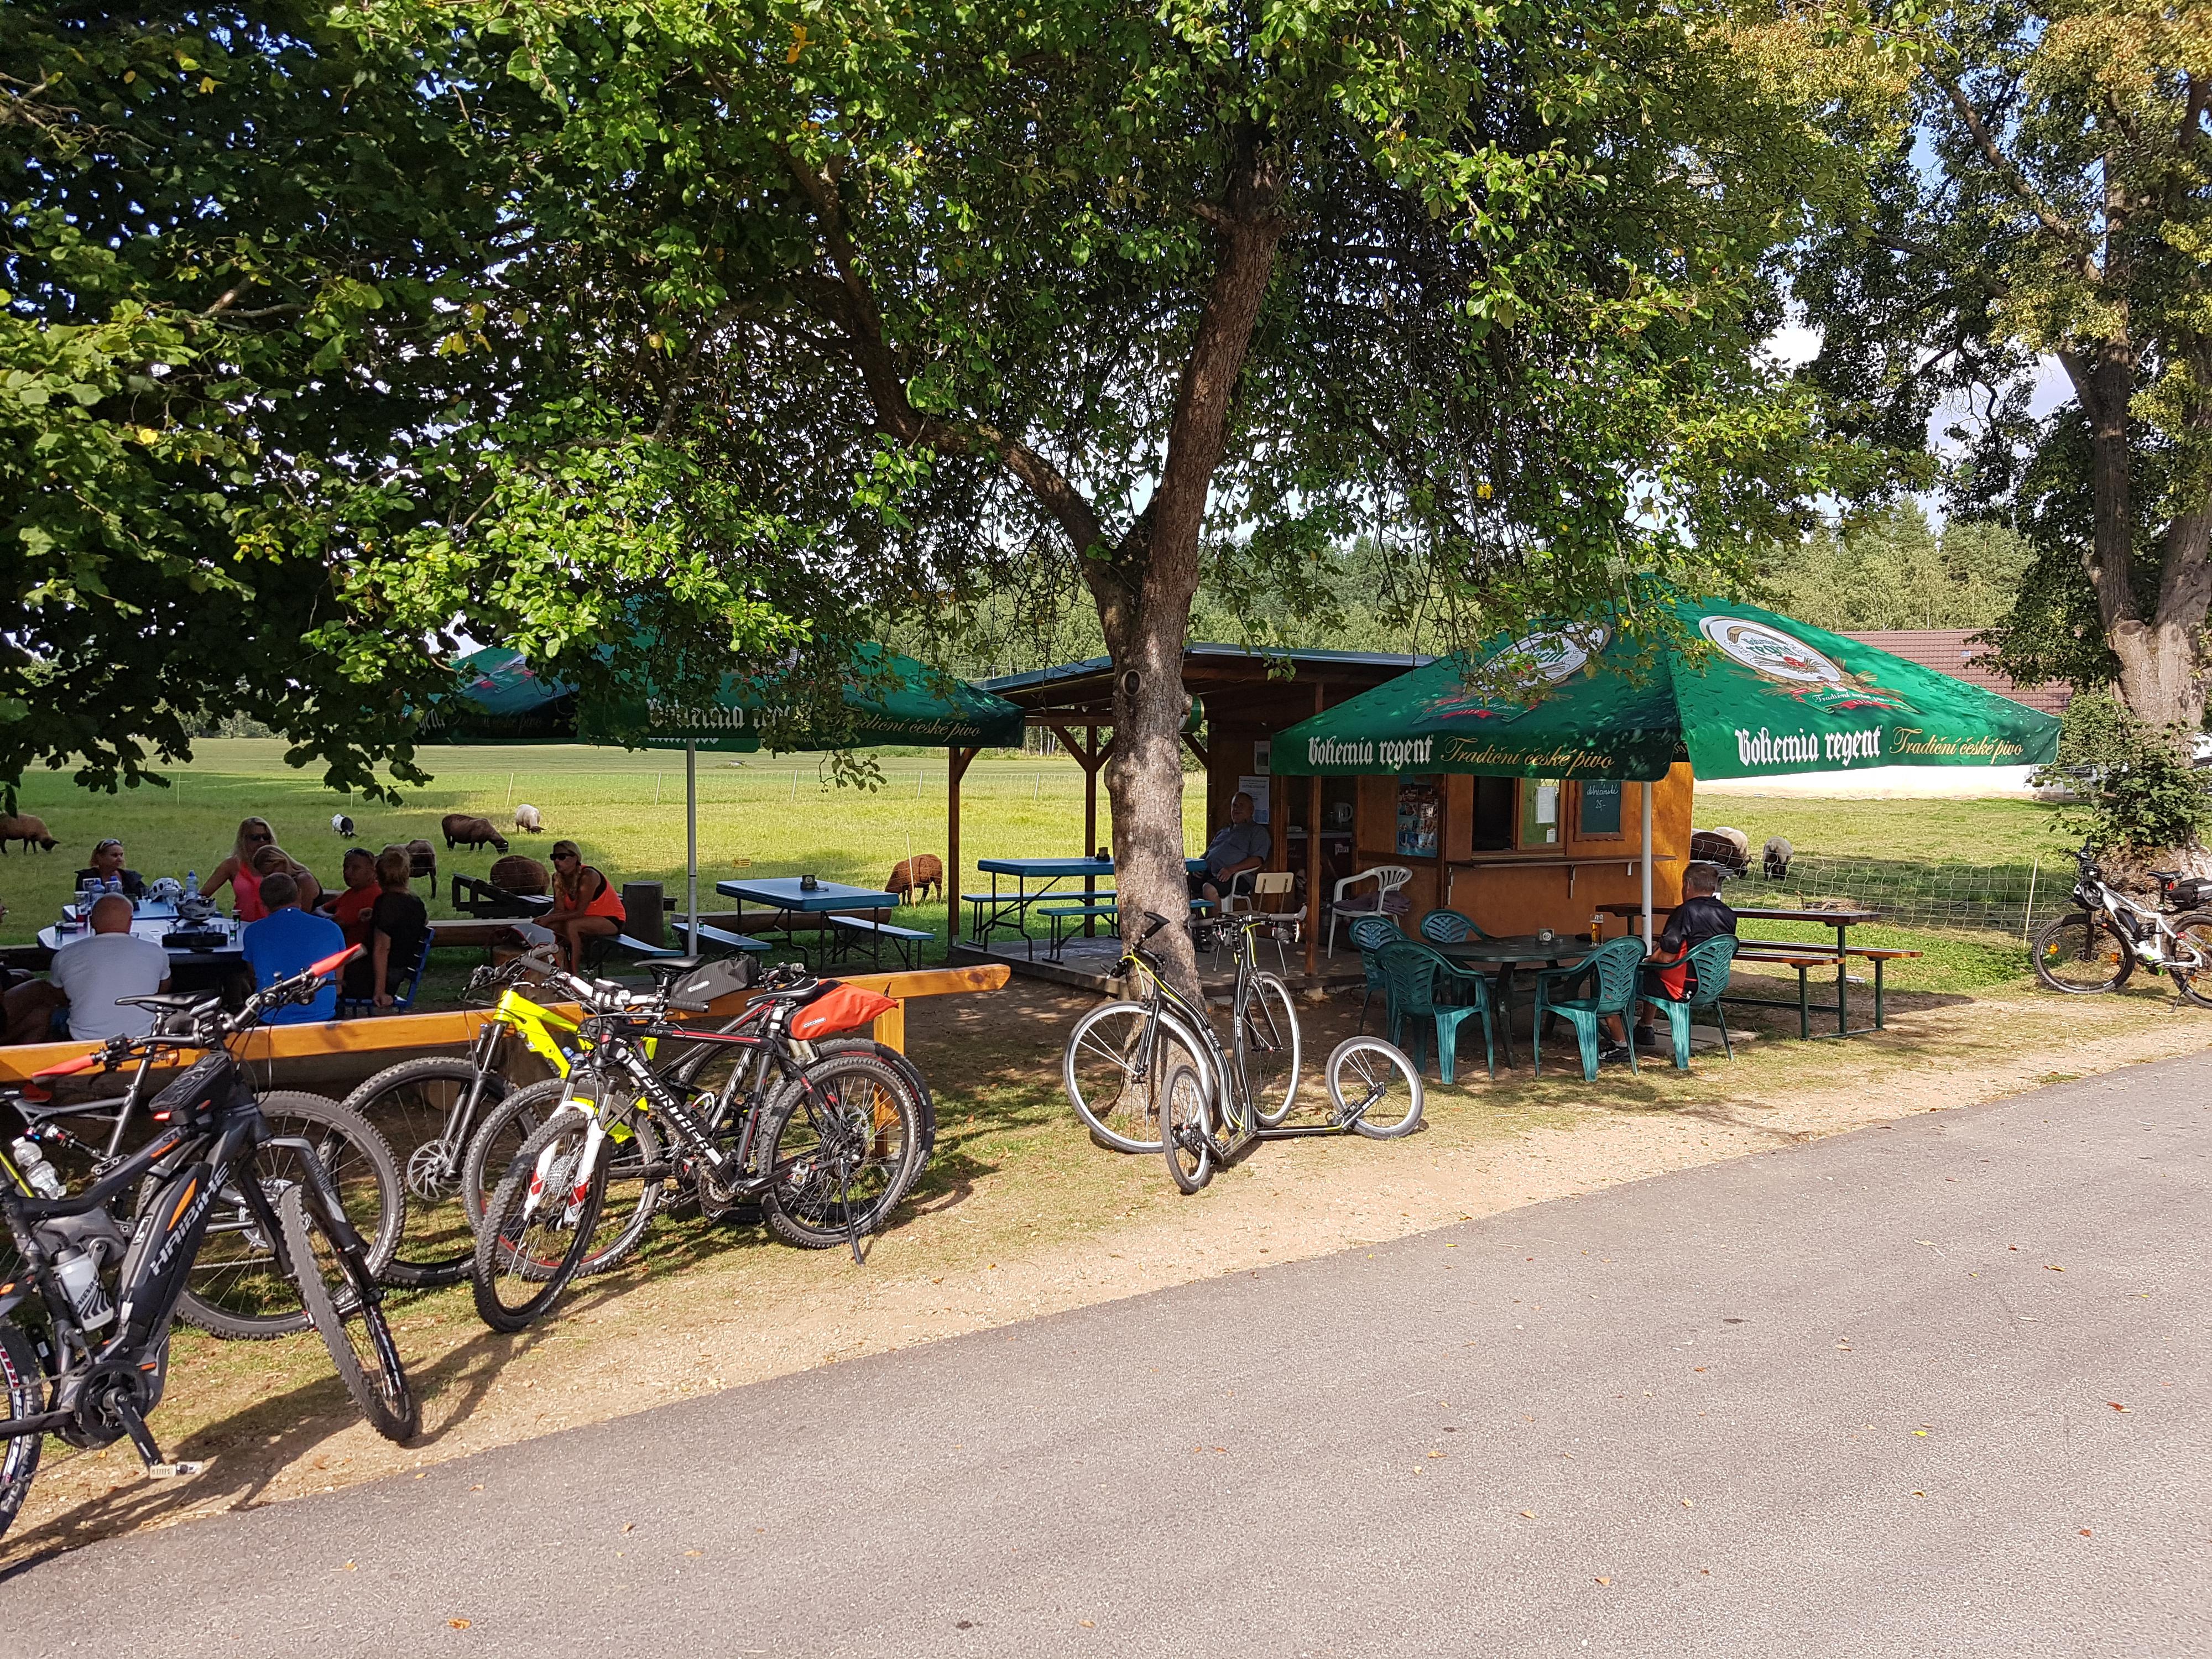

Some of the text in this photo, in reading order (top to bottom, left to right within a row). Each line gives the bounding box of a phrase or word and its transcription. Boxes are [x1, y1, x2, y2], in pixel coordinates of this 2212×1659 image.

[909, 718, 949, 735] české
[942, 720, 982, 743] pivo
[1734, 725, 2025, 767] Bohemia regent Tradiční české pivo
[1308, 734, 1615, 777] Bohemia regent Tradiční české pivo
[643, 1077, 710, 1151] PANTHER
[149, 1161, 230, 1277] HAIBIKE
[379, 1213, 395, 1258] GROUND
